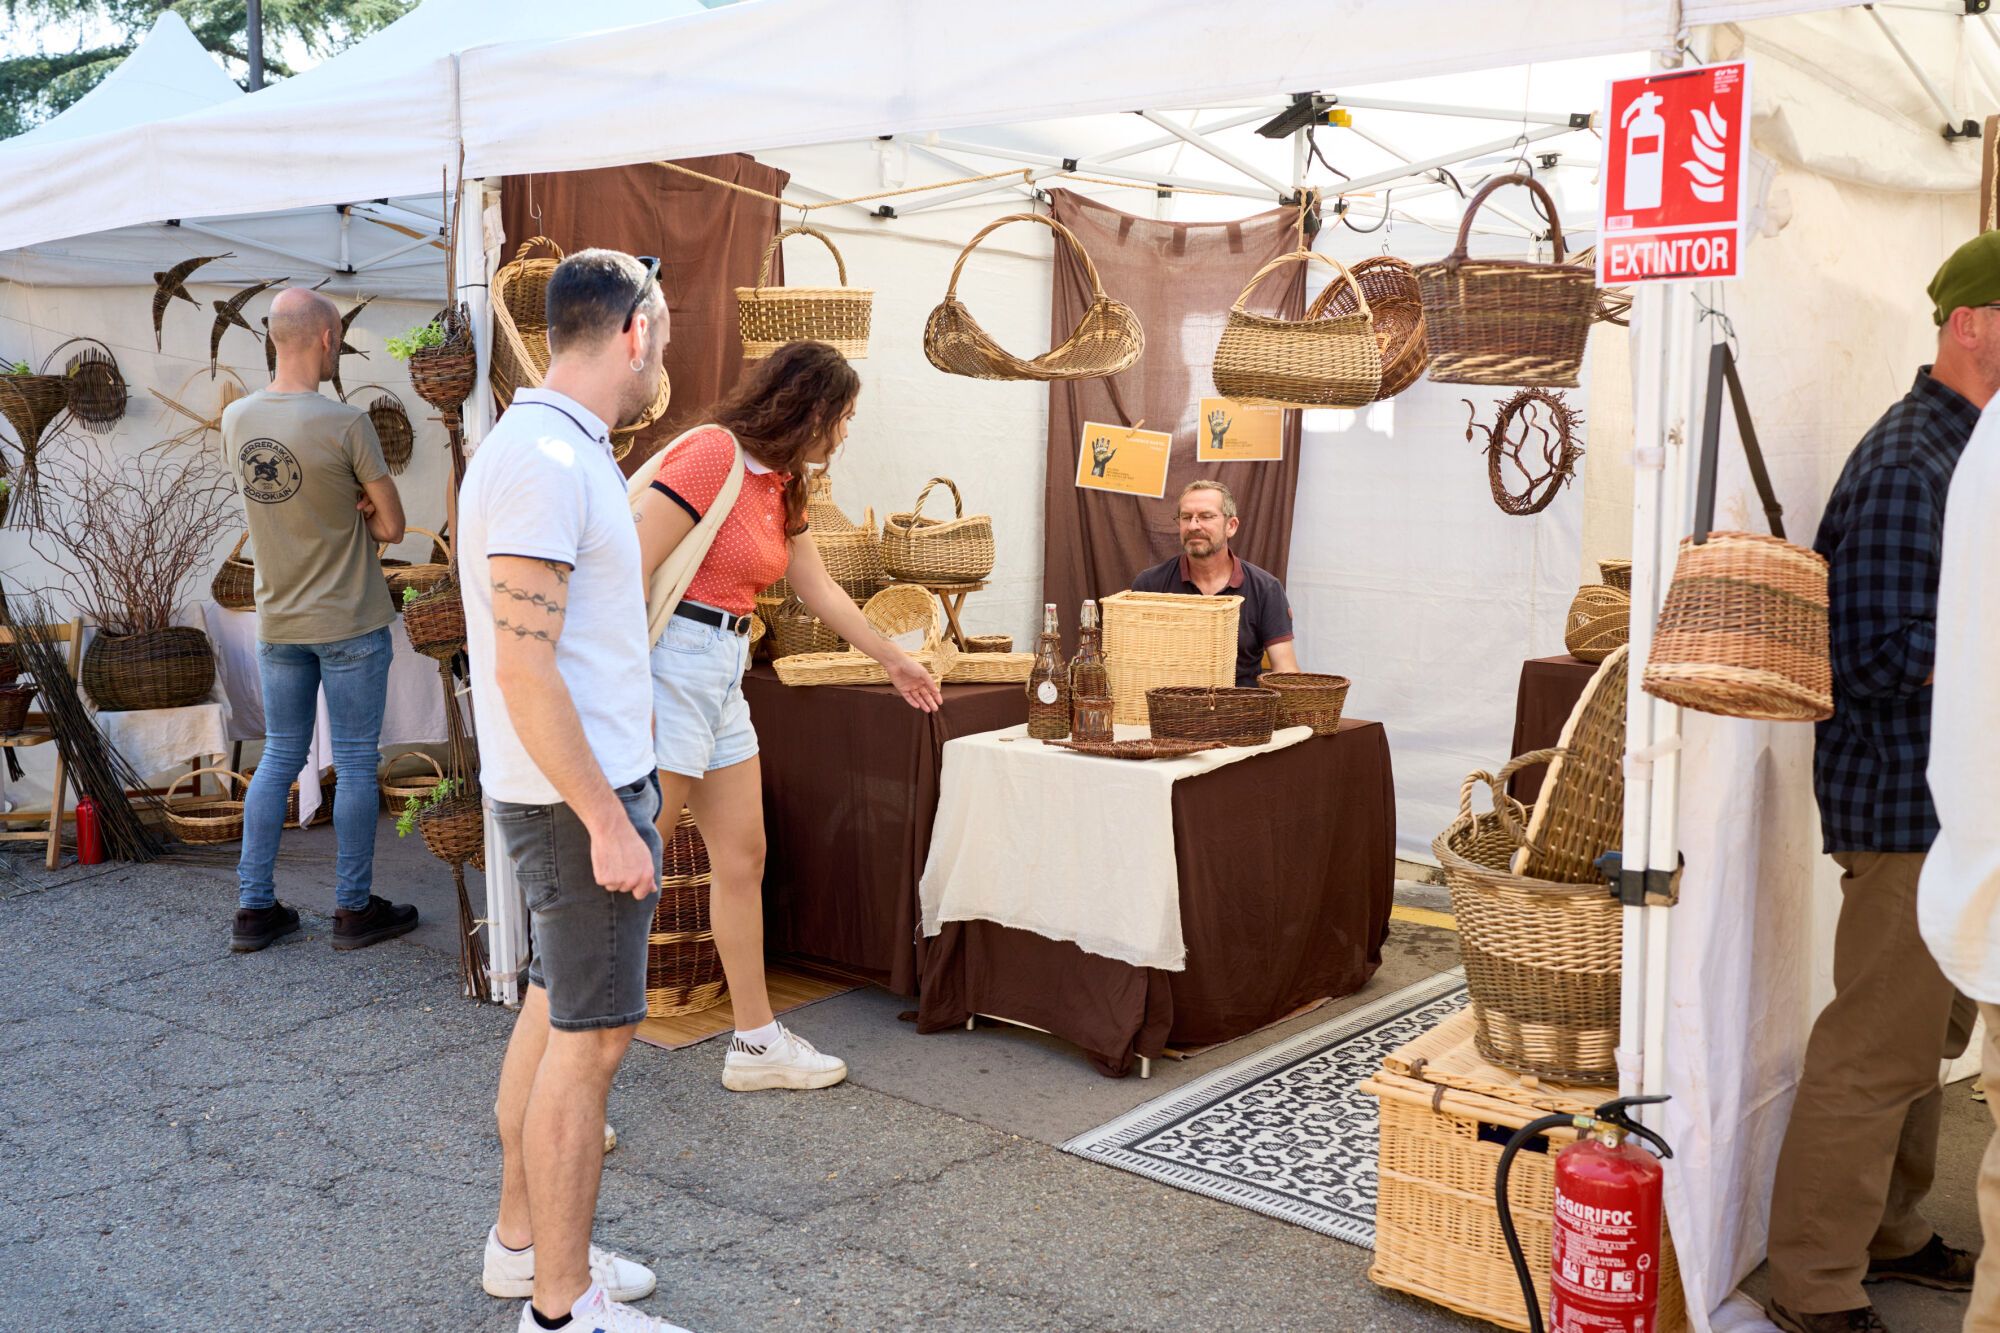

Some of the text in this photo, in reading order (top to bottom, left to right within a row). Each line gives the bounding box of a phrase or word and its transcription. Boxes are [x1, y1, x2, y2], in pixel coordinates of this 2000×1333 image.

[1610, 237, 1729, 276] EXTINTOR
[240, 441, 294, 465] BERRERAIKIZ
[1571, 1263, 1578, 1272] A
[1597, 1270, 1605, 1278] B
[1624, 1271, 1633, 1279] C
